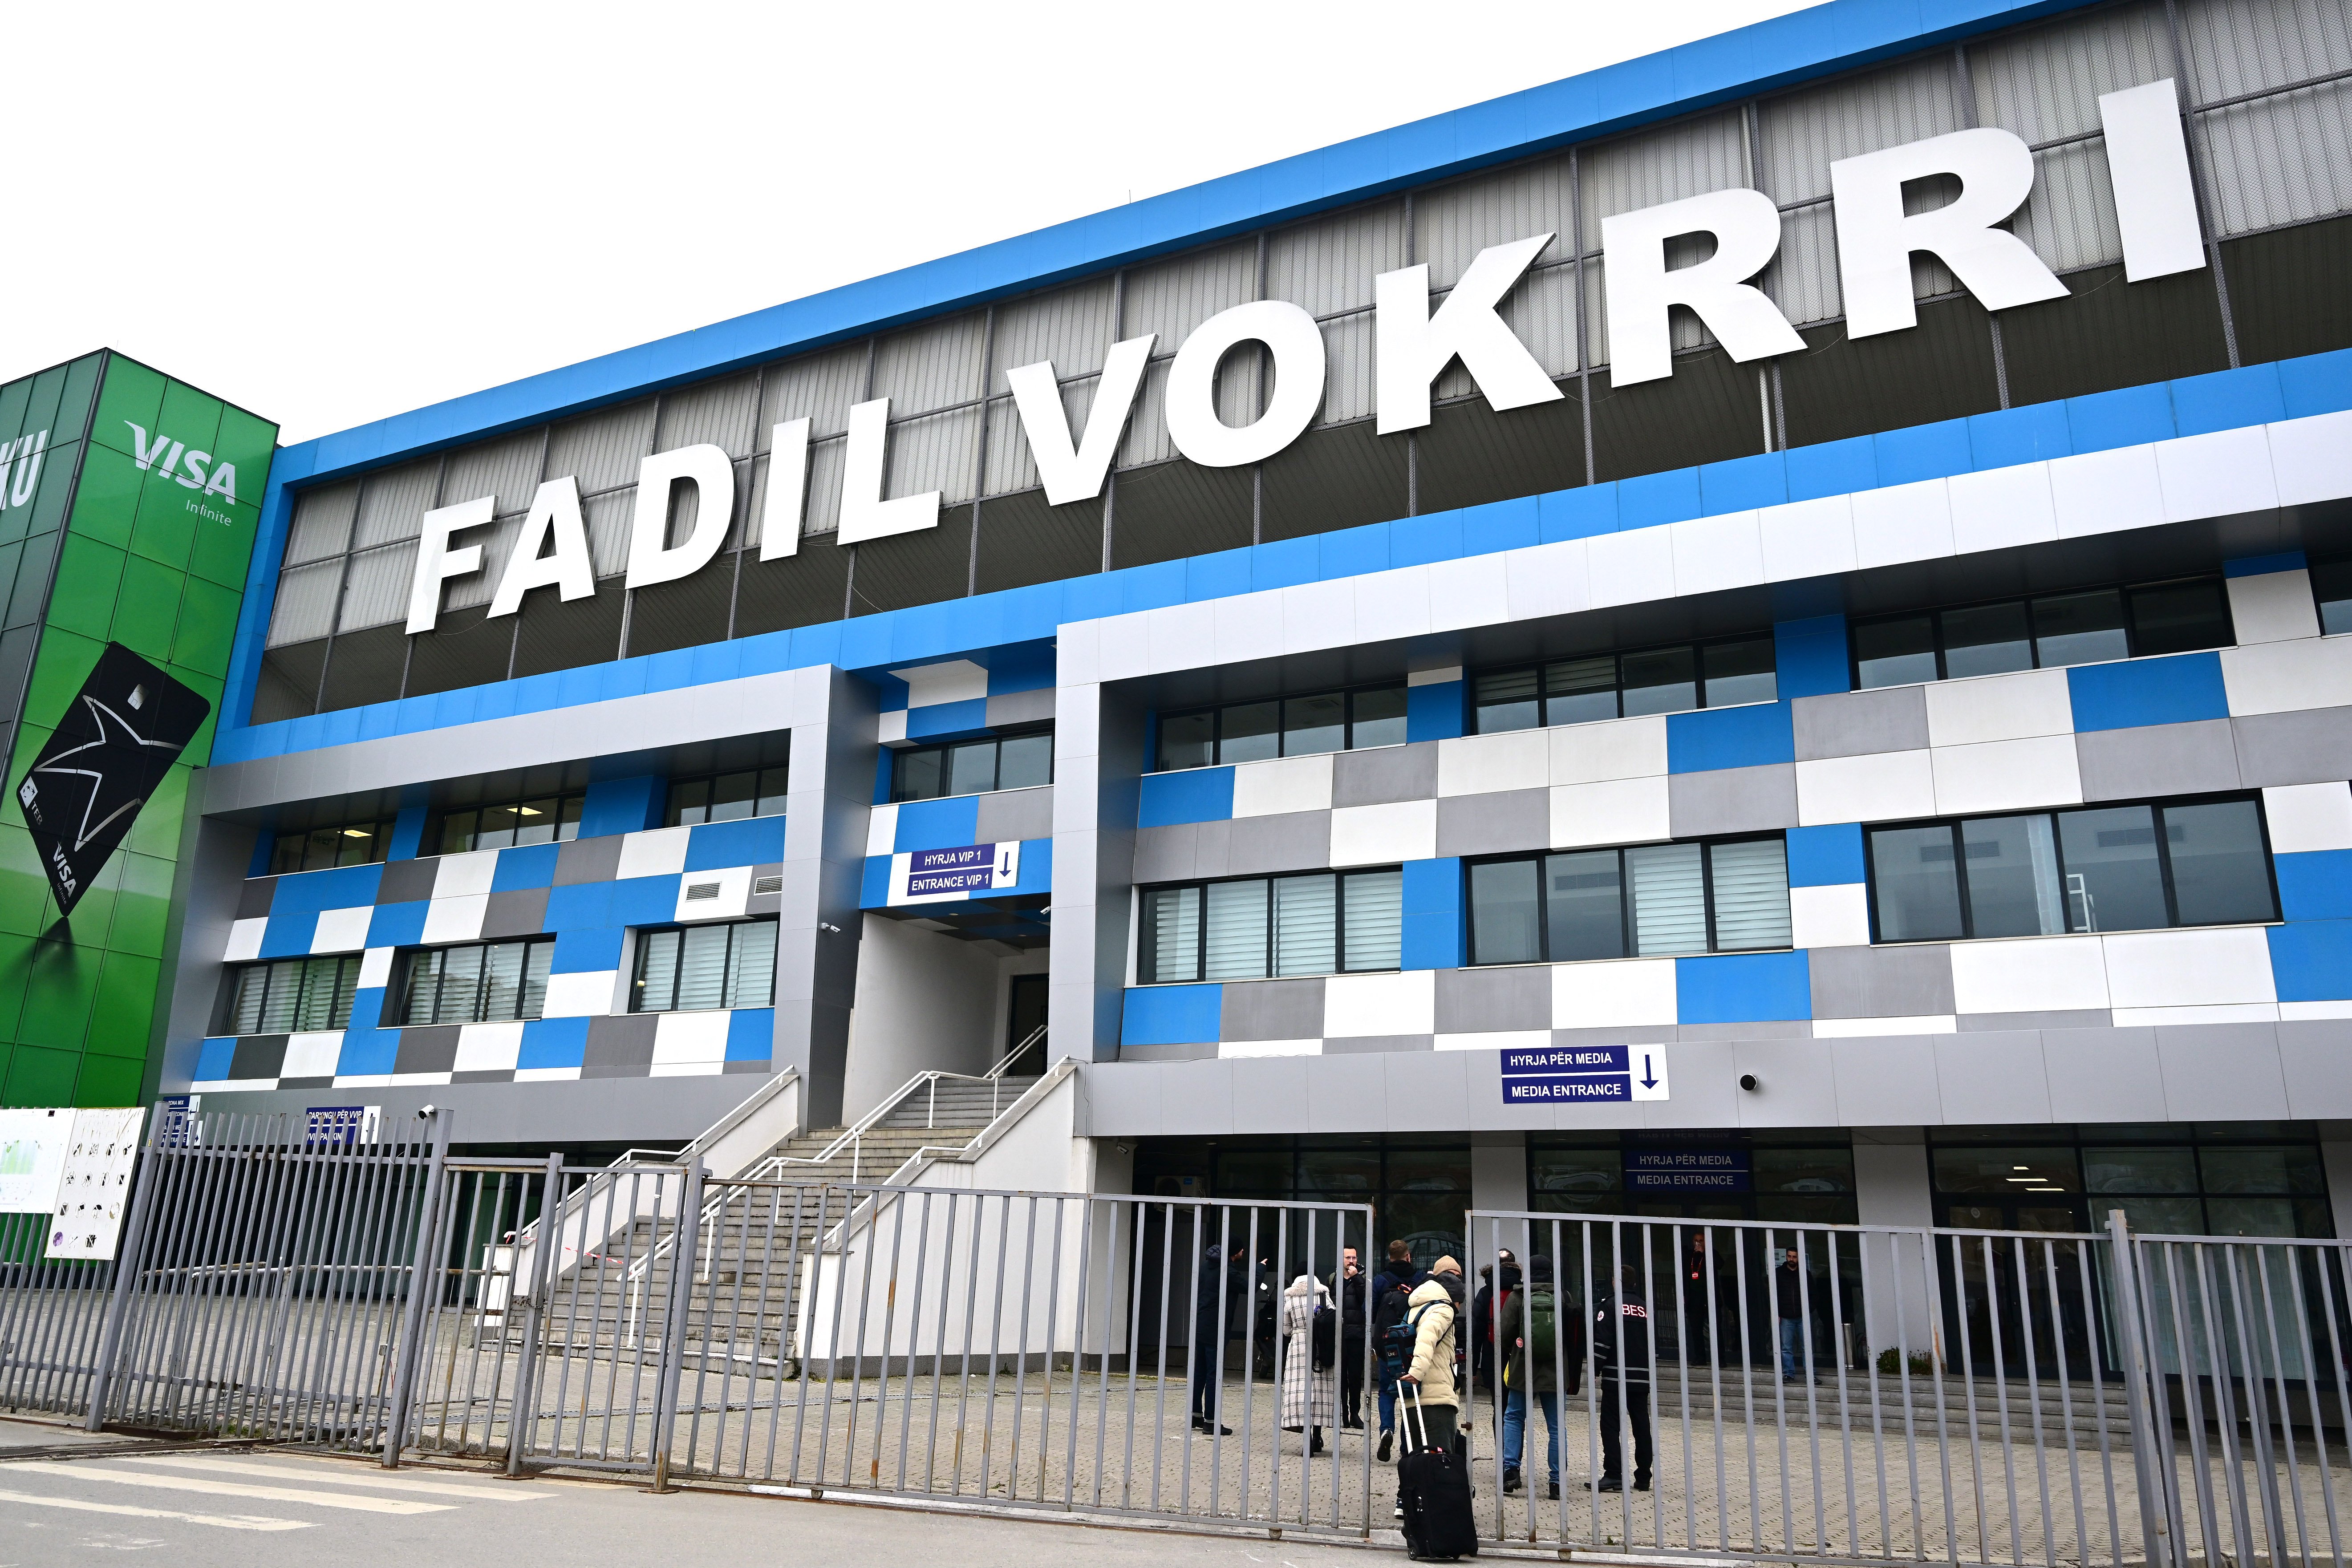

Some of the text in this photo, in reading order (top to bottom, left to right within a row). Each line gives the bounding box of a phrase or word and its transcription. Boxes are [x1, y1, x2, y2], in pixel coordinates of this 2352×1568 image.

[406, 78, 2208, 635] FADIL VOKRRI
[124, 420, 235, 506] VISA
[186, 499, 232, 527] Infinite
[31, 801, 43, 826] TEB
[925, 850, 981, 866] HYRJA VIP 1
[53, 840, 77, 898] VISA
[912, 873, 989, 891] ENTRANCE VIP 1
[57, 882, 67, 904] Infinite
[1510, 1052, 1613, 1066] HYRJA PËR MEDIA
[1512, 1084, 1622, 1097] MEDIA ENTRANCE
[1639, 1154, 1732, 1165] HYRJA PËR MEDIA
[1637, 1175, 1734, 1185] MEDIA ENTRANCE
[1622, 1304, 1647, 1318] BES
